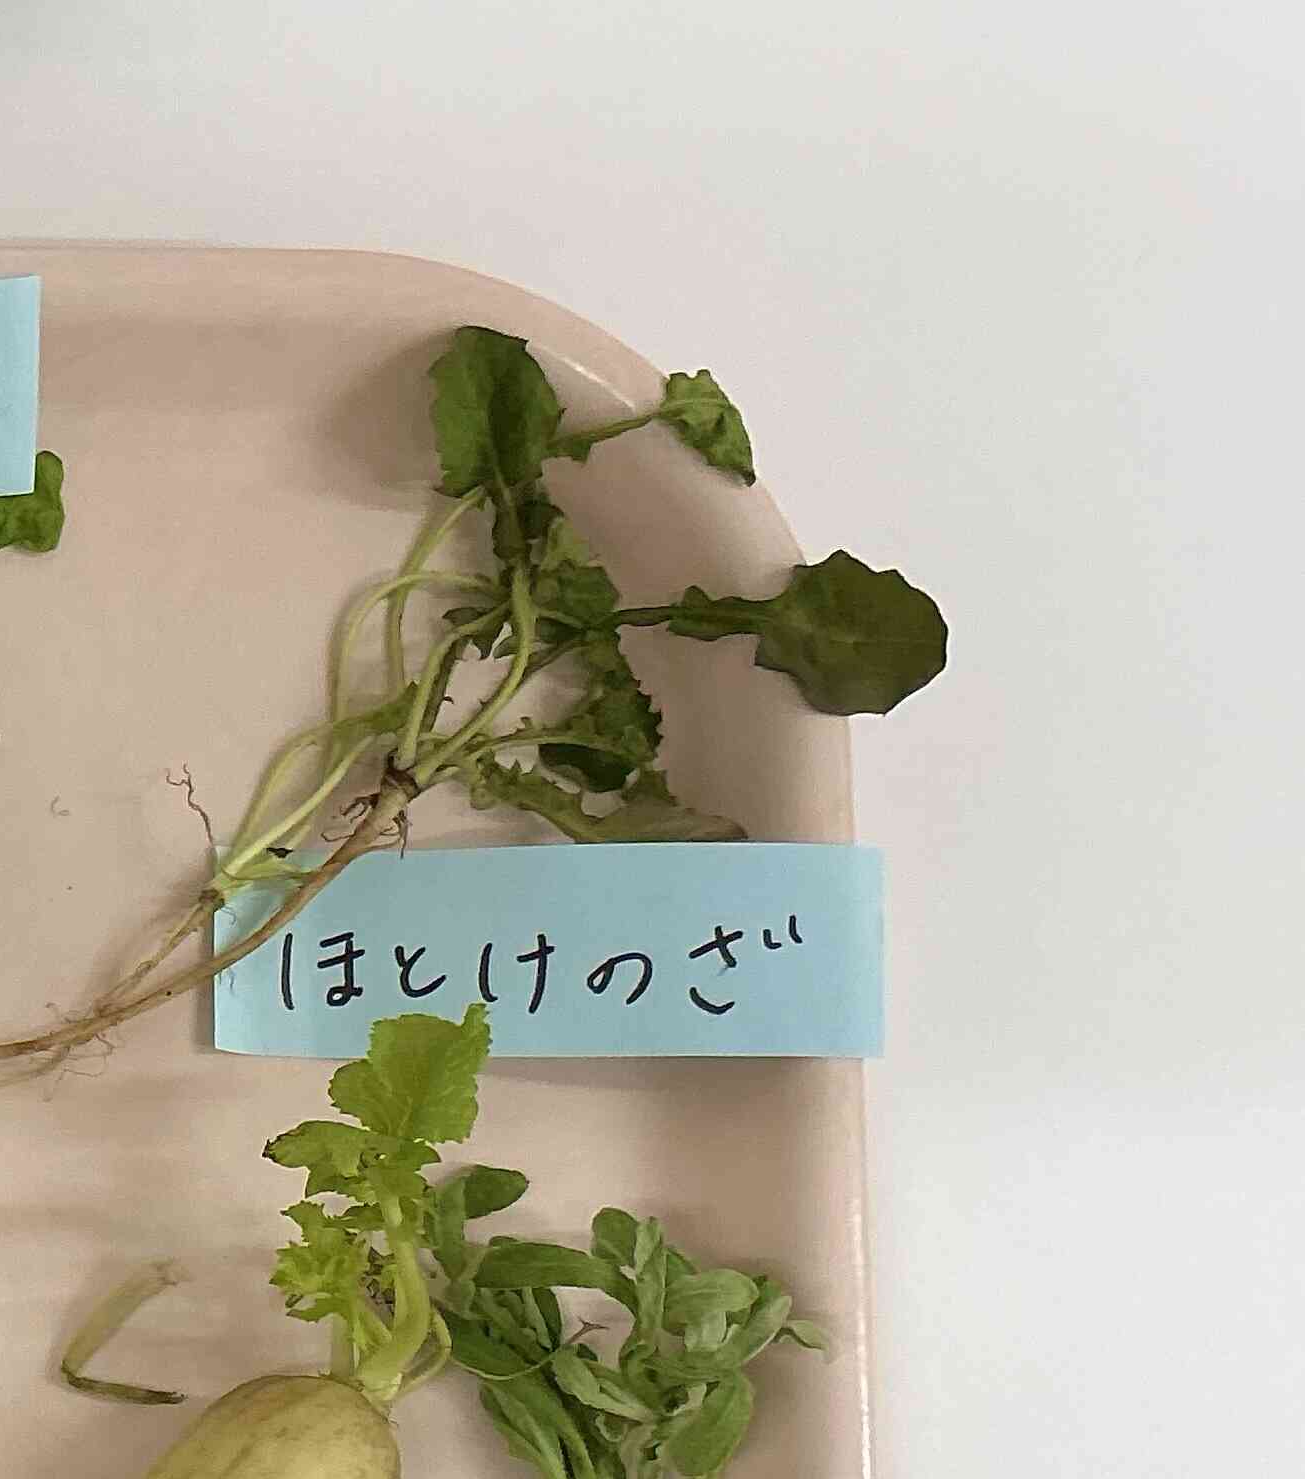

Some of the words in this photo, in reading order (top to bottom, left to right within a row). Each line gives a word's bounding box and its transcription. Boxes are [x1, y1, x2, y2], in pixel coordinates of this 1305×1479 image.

[280, 913, 804, 1015] ほとけのざ
